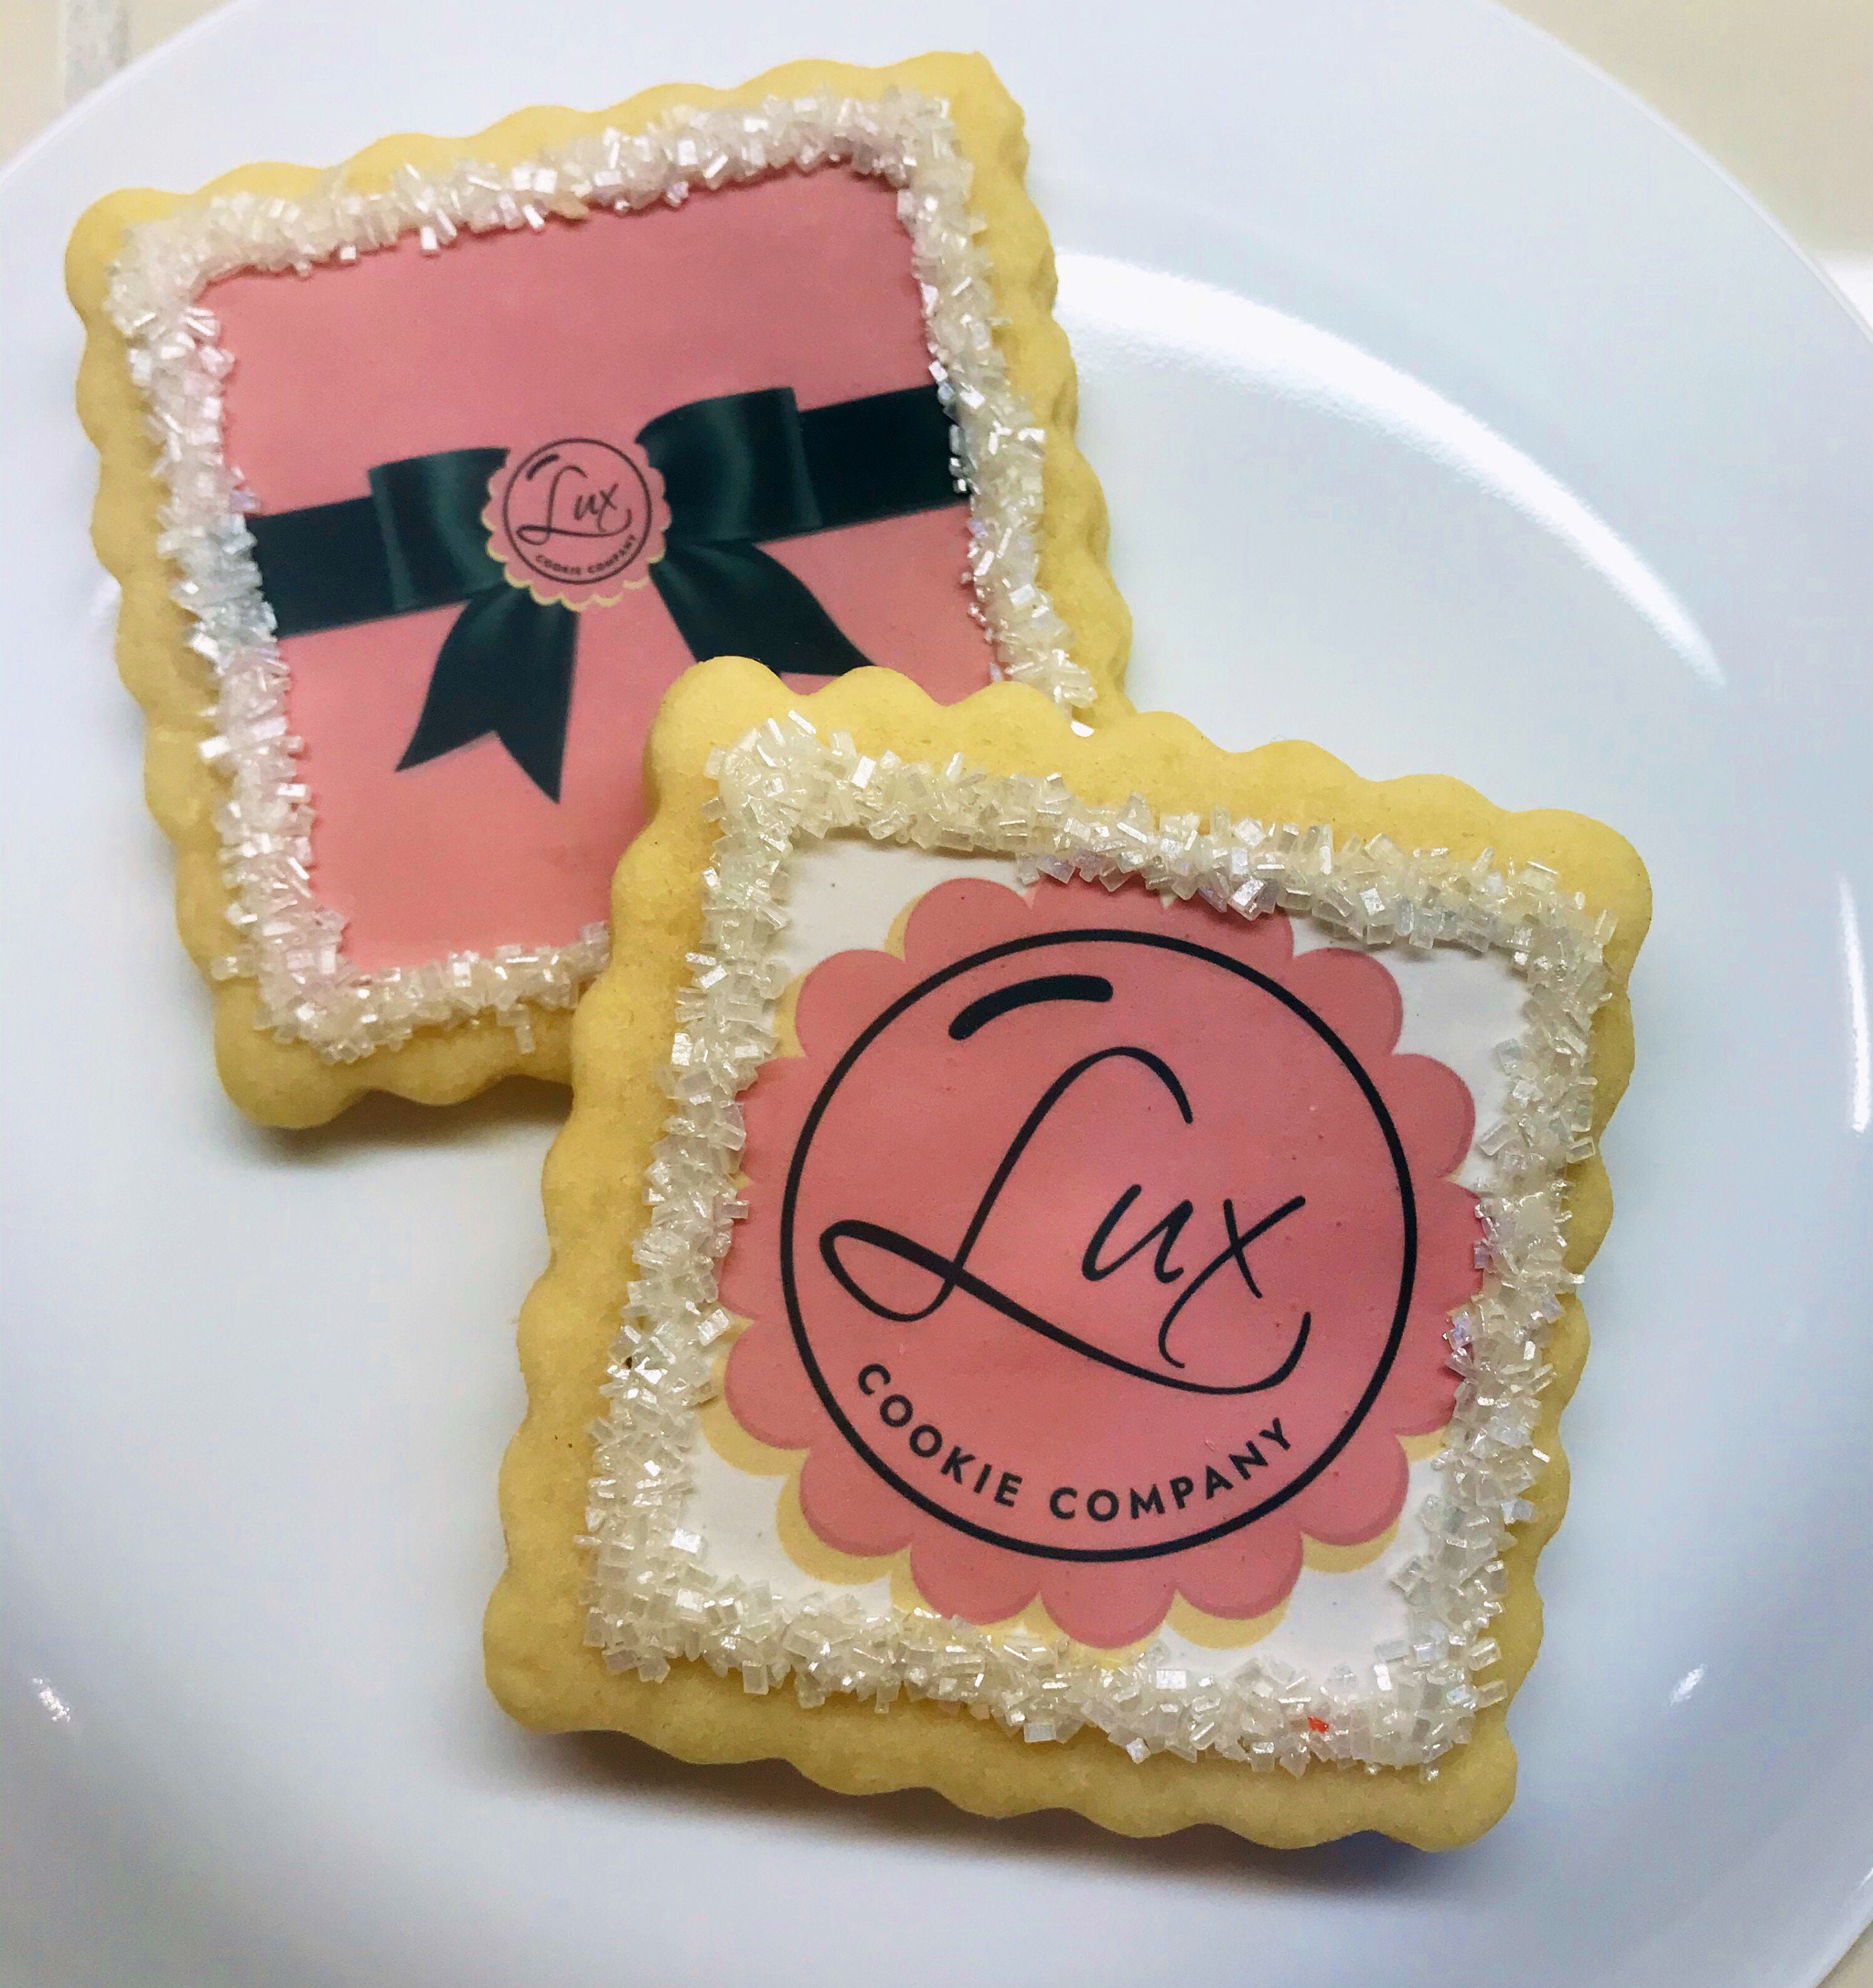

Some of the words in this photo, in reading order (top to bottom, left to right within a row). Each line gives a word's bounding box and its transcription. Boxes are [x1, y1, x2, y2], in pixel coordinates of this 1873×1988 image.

[515, 465, 633, 545] Lux
[819, 1046, 1312, 1395] Lux
[856, 1362, 1023, 1508] COOKIE
[1049, 1417, 1292, 1523] COMPANY
